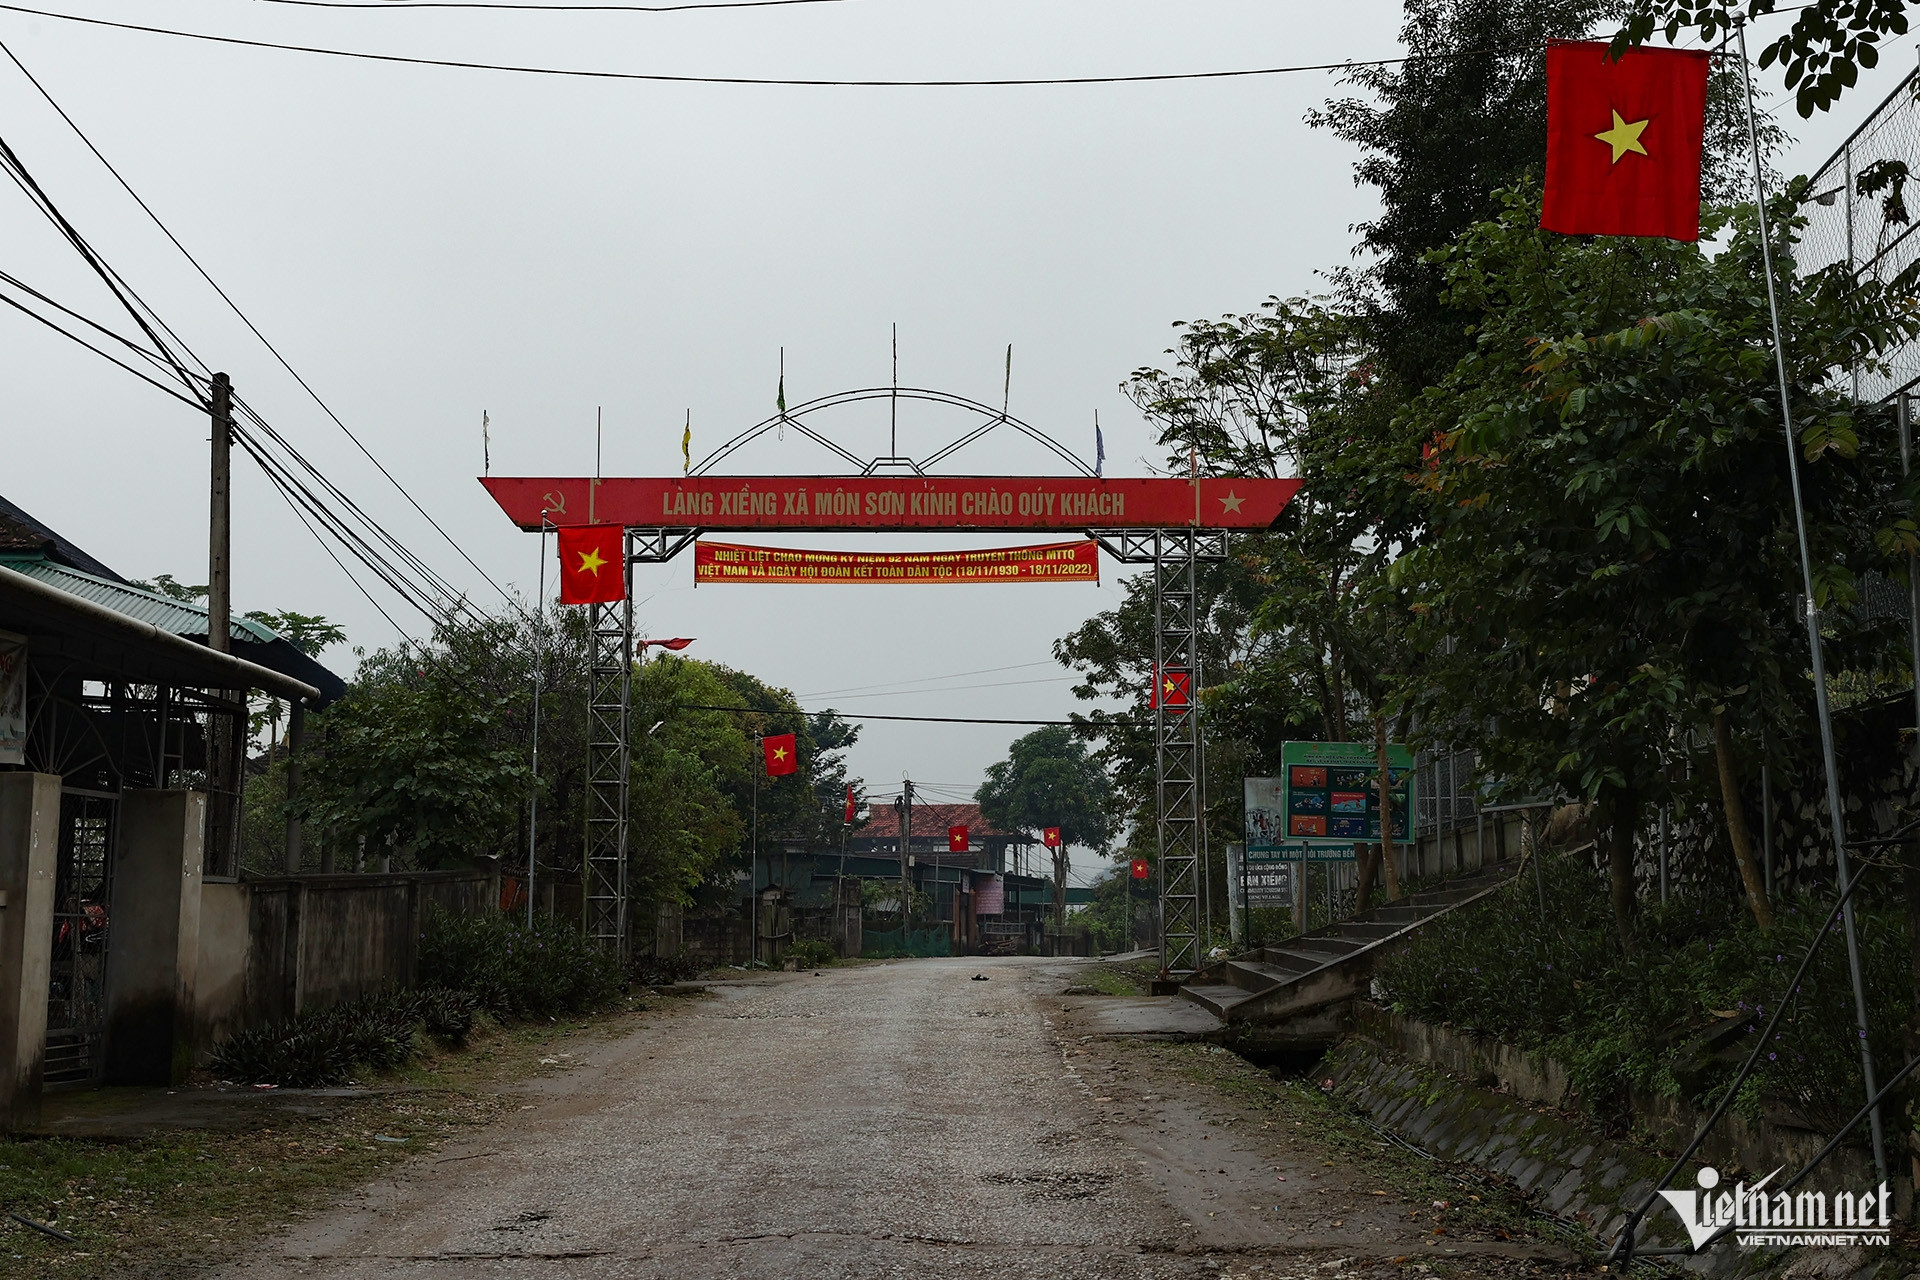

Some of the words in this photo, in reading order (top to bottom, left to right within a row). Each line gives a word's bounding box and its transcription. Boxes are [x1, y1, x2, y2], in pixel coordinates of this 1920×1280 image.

[663, 485, 714, 515] LÀNG
[718, 482, 777, 515] XIỀNG
[782, 487, 809, 515] XÃ
[815, 487, 860, 515] MÔN
[865, 489, 905, 515] SƠN
[910, 485, 957, 515] KÍNH
[961, 486, 1013, 515] CHÀO
[1061, 488, 1125, 516] KHÁCH
[714, 549, 746, 564] NHIỆT
[748, 550, 771, 564] LIỆT
[888, 555, 902, 563] 92
[1046, 549, 1075, 561] MTTQ
[697, 563, 721, 578] VIỆT
[722, 565, 748, 576] NAM
[751, 562, 766, 576] VÀ
[768, 564, 797, 576] NGÀY
[800, 565, 818, 579] HỘI
[821, 565, 851, 577] ĐOÀN
[853, 564, 873, 577] KẾT
[876, 565, 903, 577] TOÀN
[907, 565, 930, 577] DÂN
[932, 565, 953, 579] TỘC
[956, 565, 1019, 578] (18/11/1930
[1029, 563, 1092, 576] 18/11/2022)
[1248, 850, 1270, 859] CHUNG
[1270, 850, 1281, 859] TAY
[1289, 849, 1303, 860] MỘT
[1317, 848, 1342, 858] TRƯỜNG
